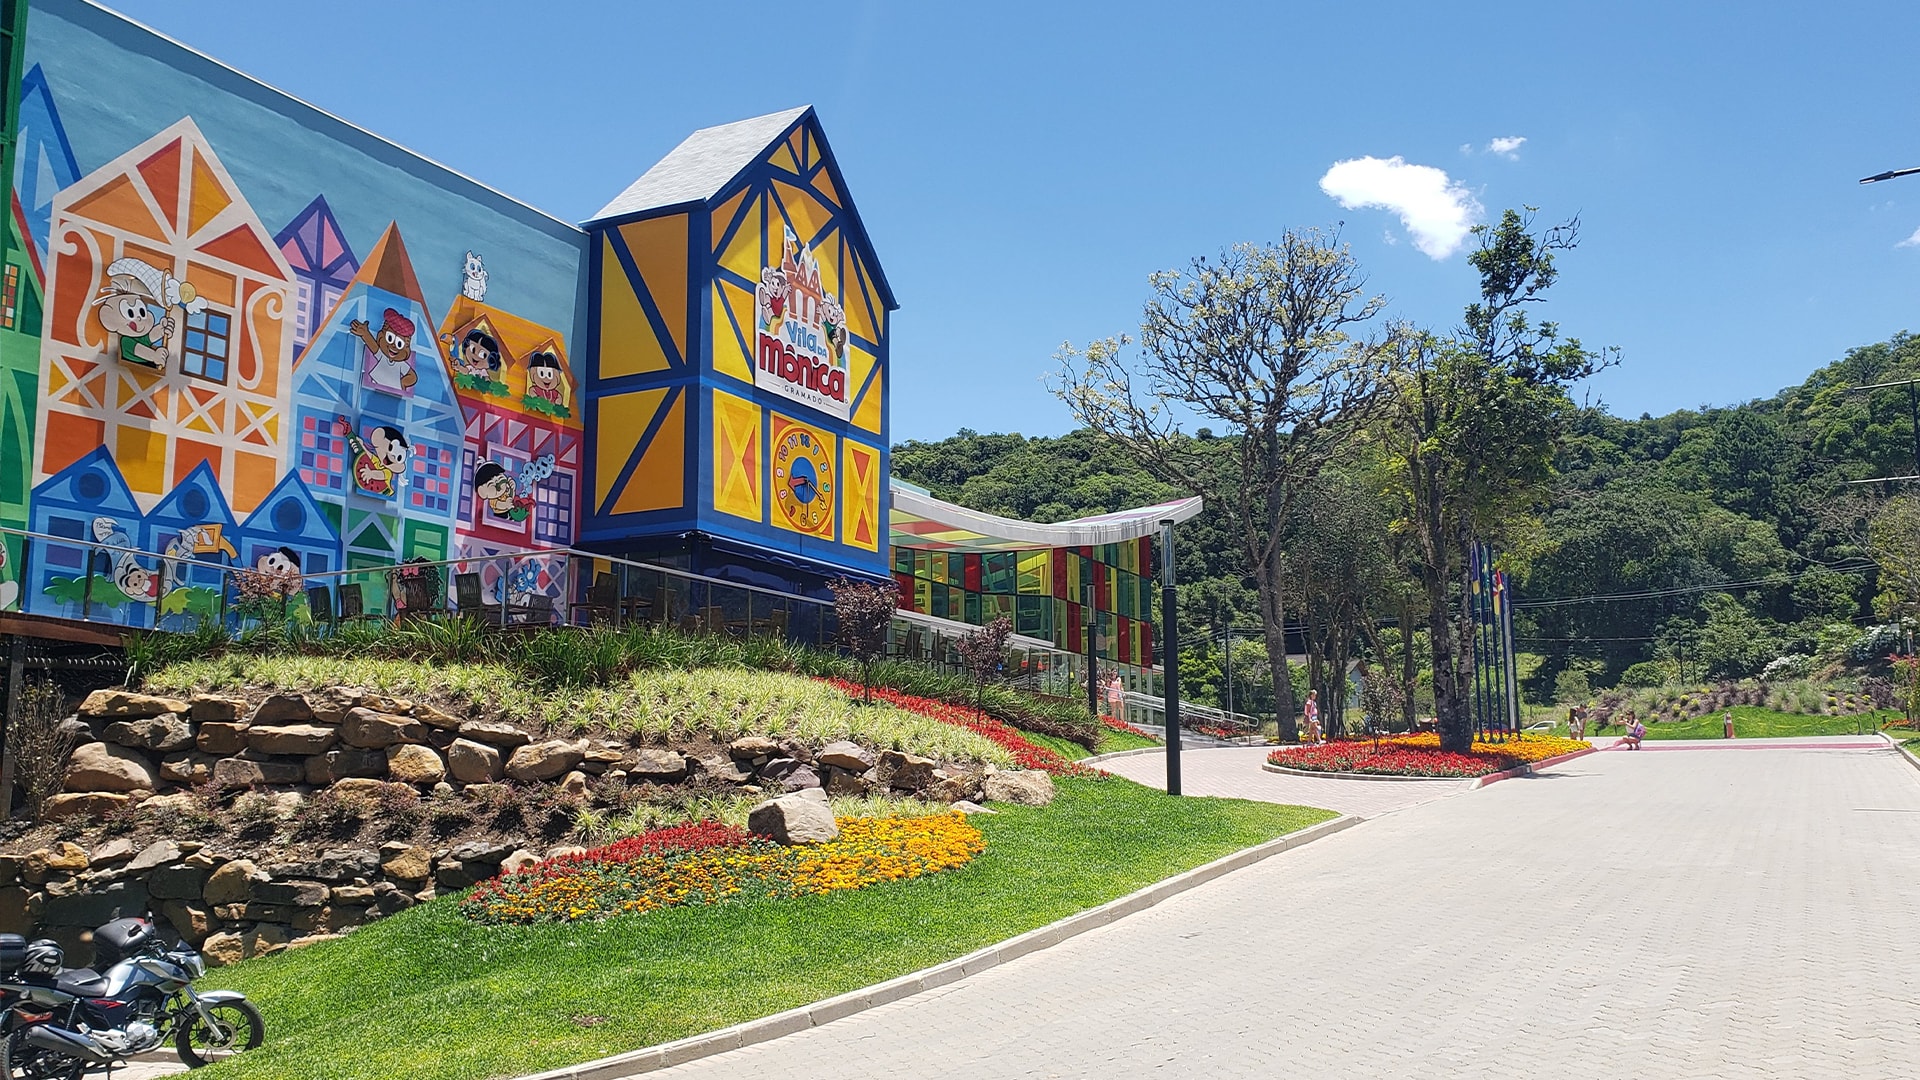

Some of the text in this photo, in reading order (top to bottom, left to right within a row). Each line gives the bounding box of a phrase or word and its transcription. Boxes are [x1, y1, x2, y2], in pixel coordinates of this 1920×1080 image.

[786, 321, 827, 358] Vila DA
[784, 385, 822, 404] GRAMADO
[788, 434, 798, 449] 11
[800, 434, 810, 448] 12
[779, 445, 788, 462] 10
[820, 462, 828, 473] 2
[800, 513, 808, 526] 6
[812, 512, 818, 524] 5
